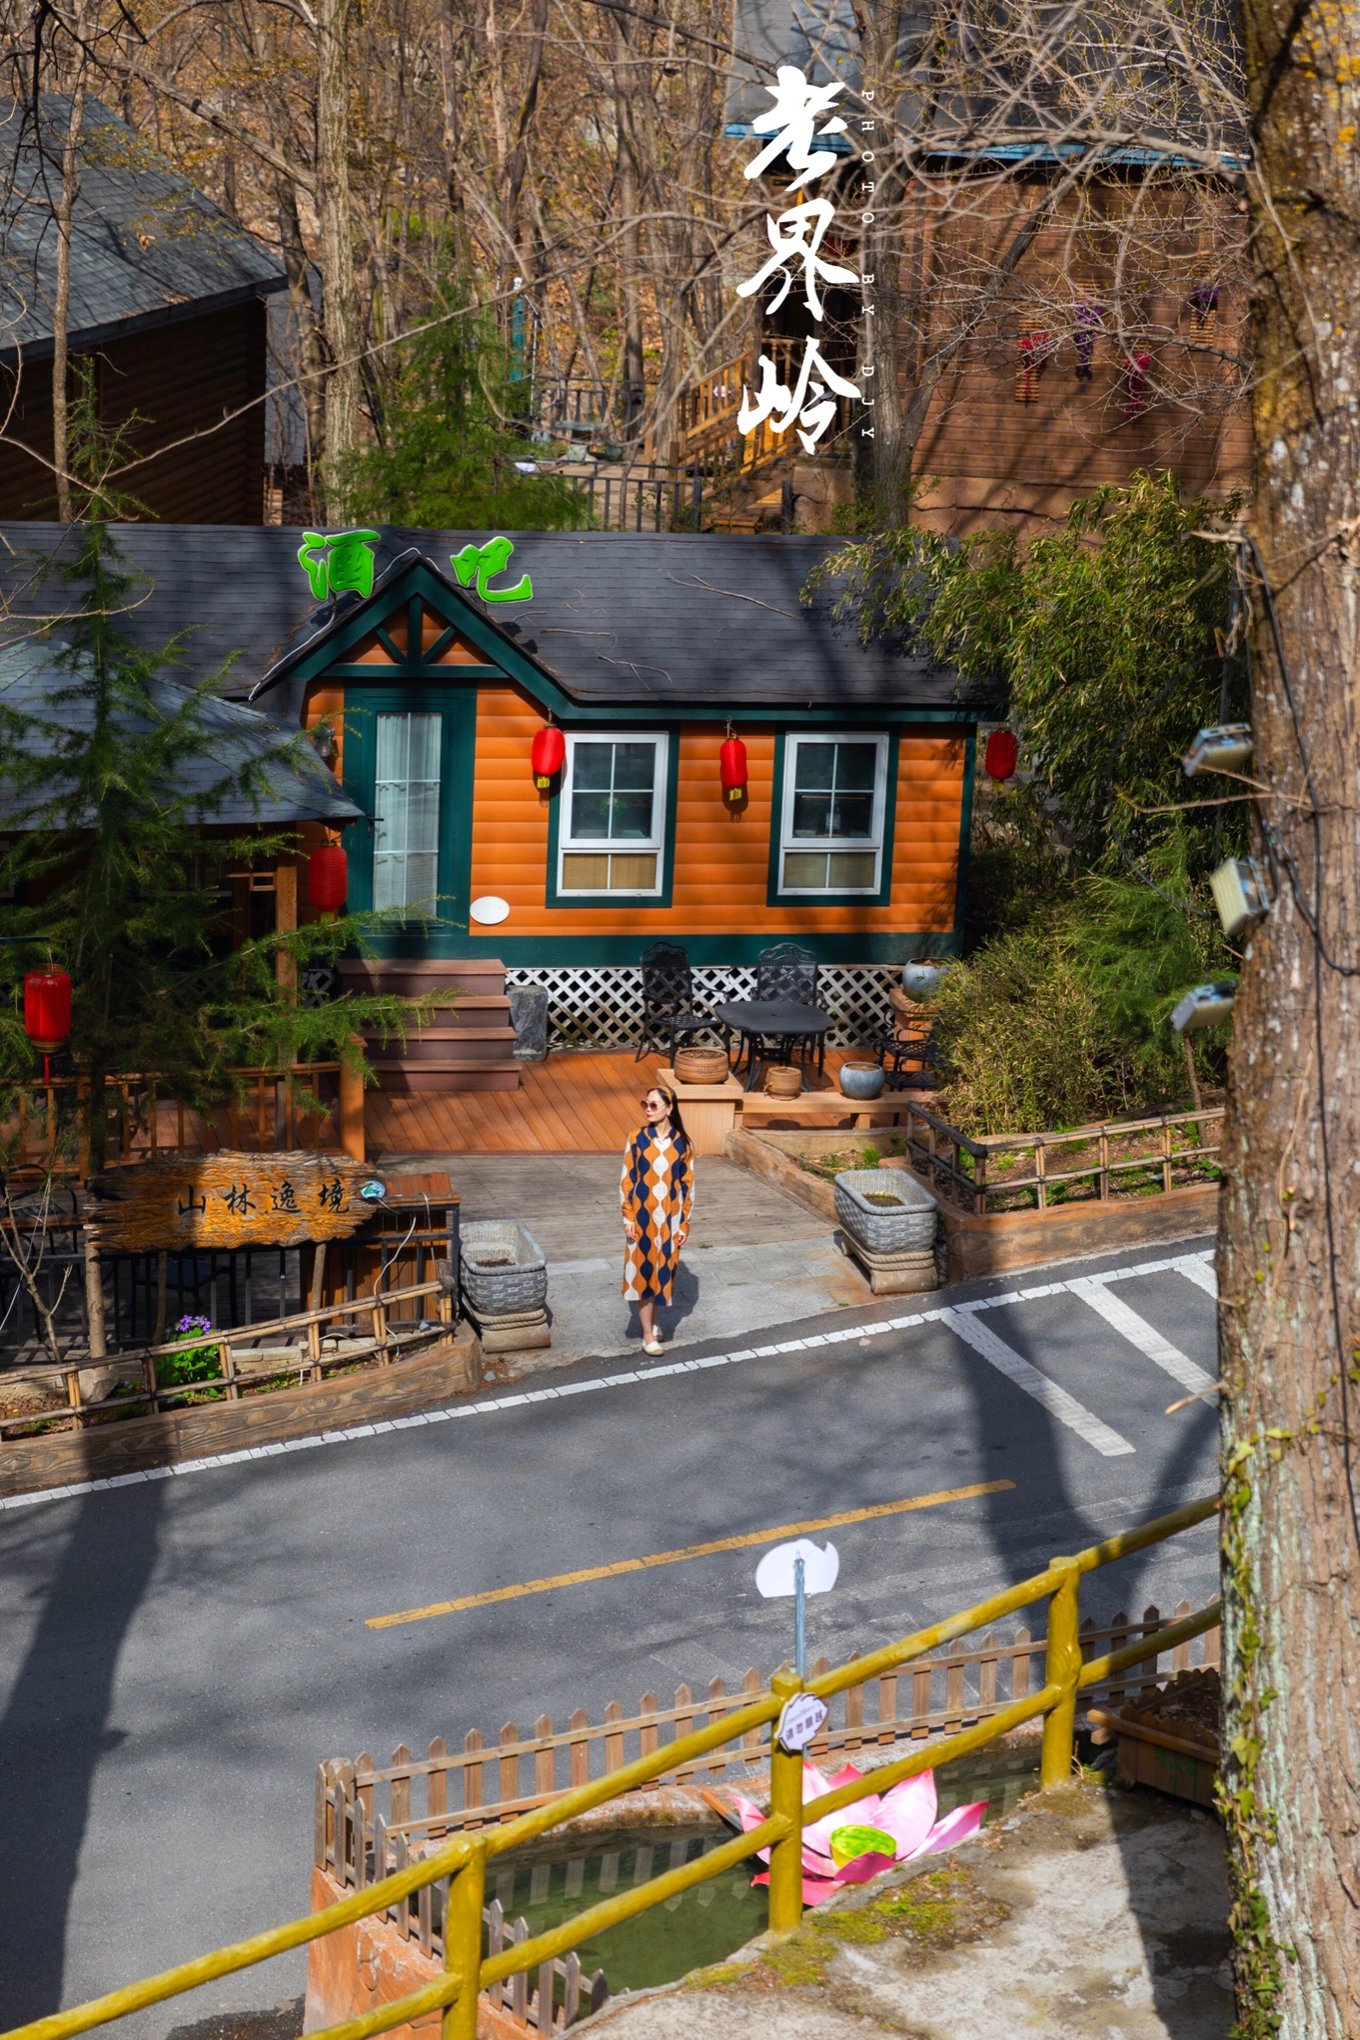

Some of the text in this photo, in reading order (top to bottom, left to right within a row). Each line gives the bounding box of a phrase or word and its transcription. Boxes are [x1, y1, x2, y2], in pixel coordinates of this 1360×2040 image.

[298, 529, 533, 603] 酒吧
[177, 1177, 350, 1217] 山林逸境
